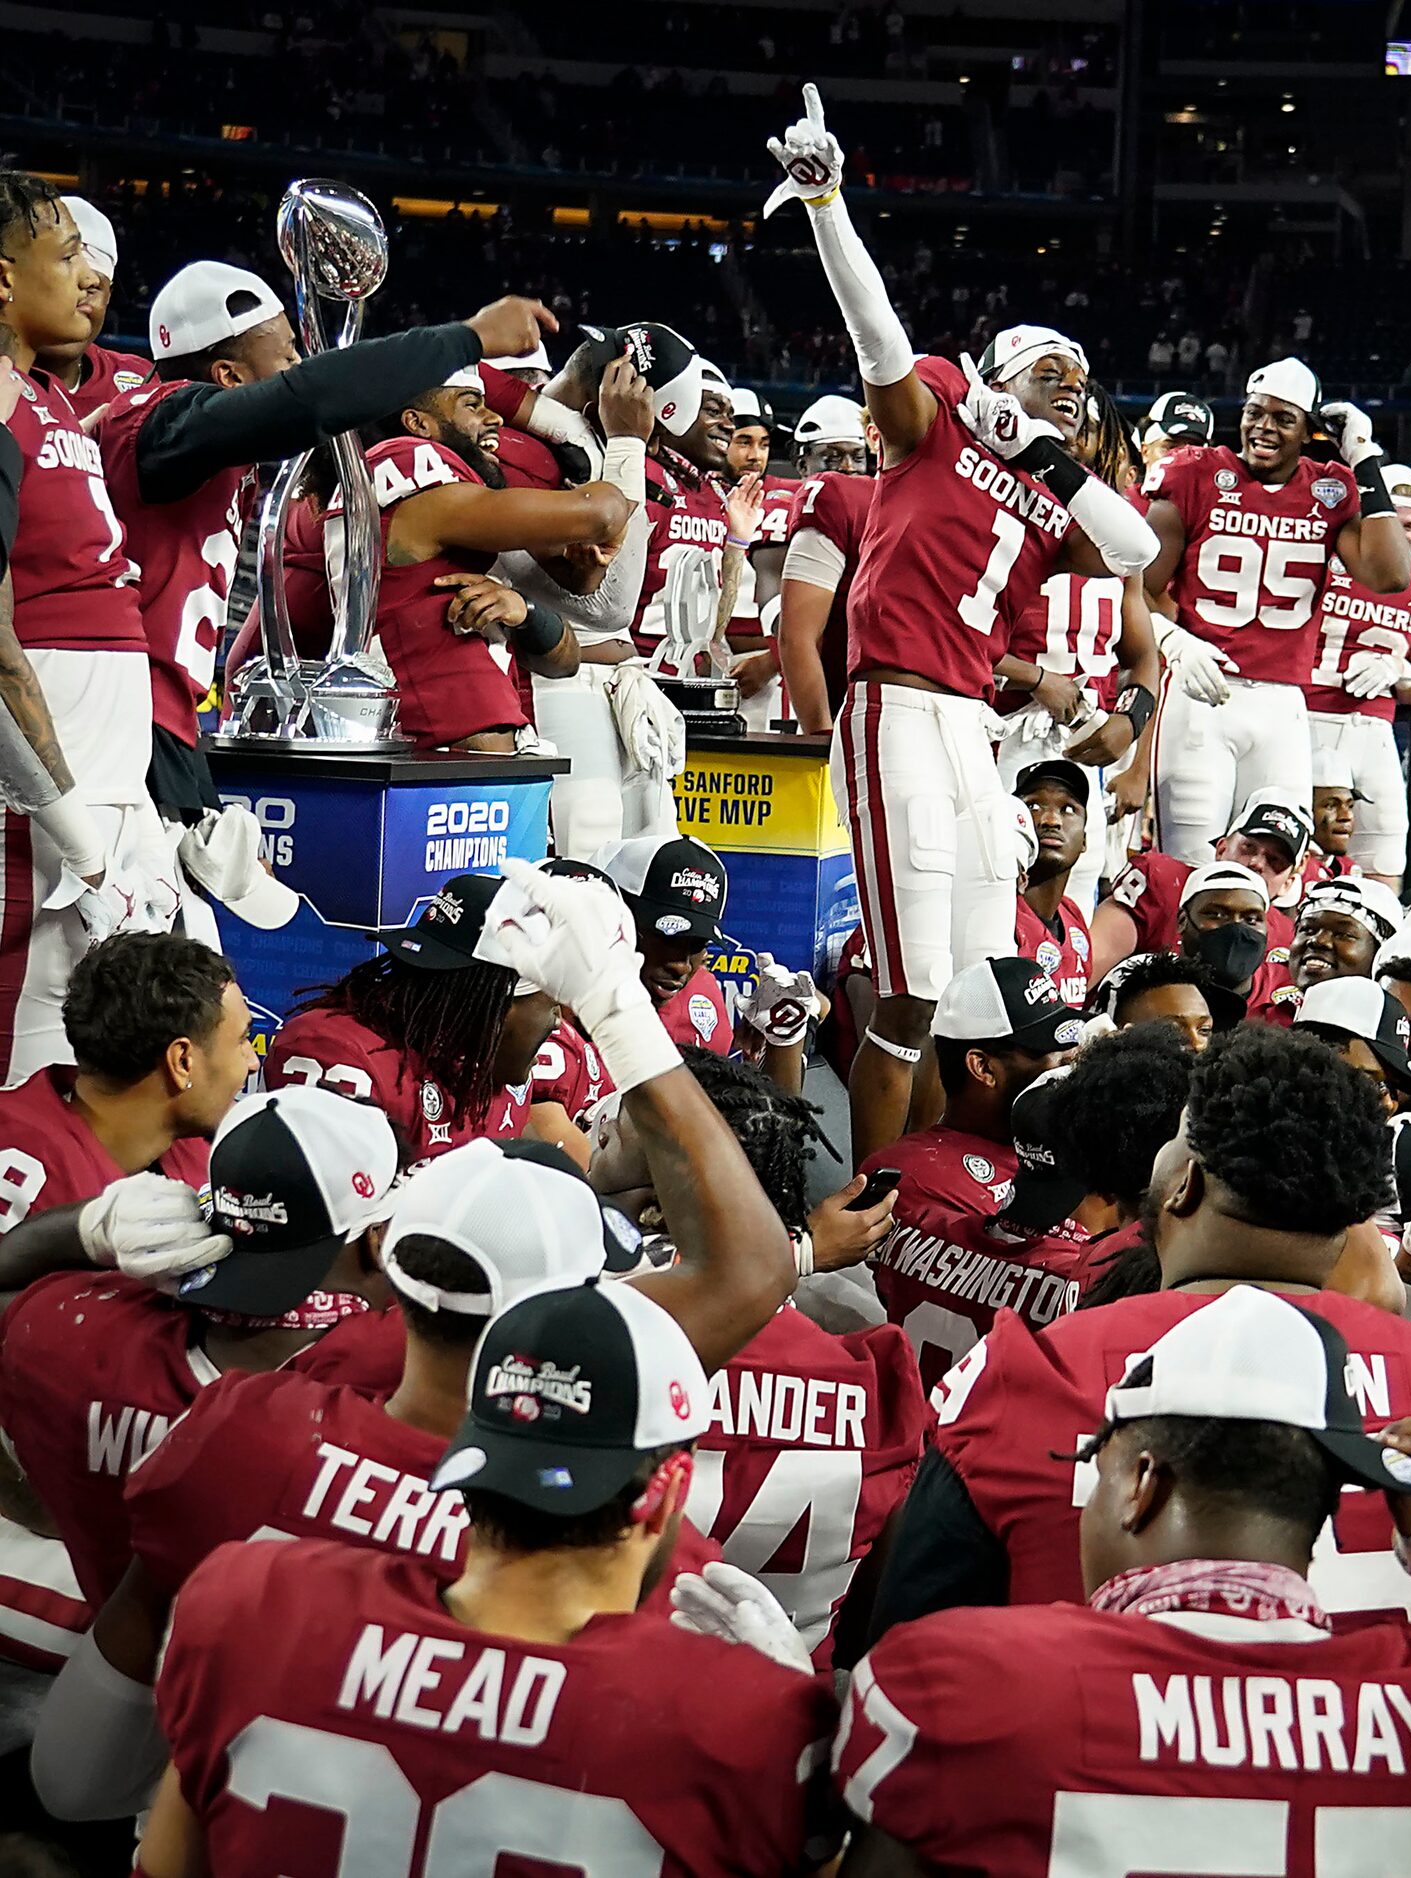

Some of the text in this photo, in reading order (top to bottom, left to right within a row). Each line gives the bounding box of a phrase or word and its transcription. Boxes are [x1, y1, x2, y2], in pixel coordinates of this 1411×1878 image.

[373, 444, 460, 505] 44
[801, 480, 825, 513] 7
[1209, 508, 1328, 541] SOONERS
[957, 508, 1026, 636] 1
[1195, 535, 1326, 631] 95
[1036, 573, 1125, 678] 10
[684, 771, 773, 796] SANFORD
[427, 801, 509, 836] 2020
[720, 798, 772, 826] MVP
[425, 835, 507, 873] CHAMPIONS
[432, 894, 464, 925] PIONS
[428, 1122, 451, 1145] XII
[537, 1361, 581, 1382] Bowl
[486, 1365, 592, 1415] CHAMPIONS
[302, 1441, 472, 1561] TERR
[338, 1625, 568, 1747] MEAD
